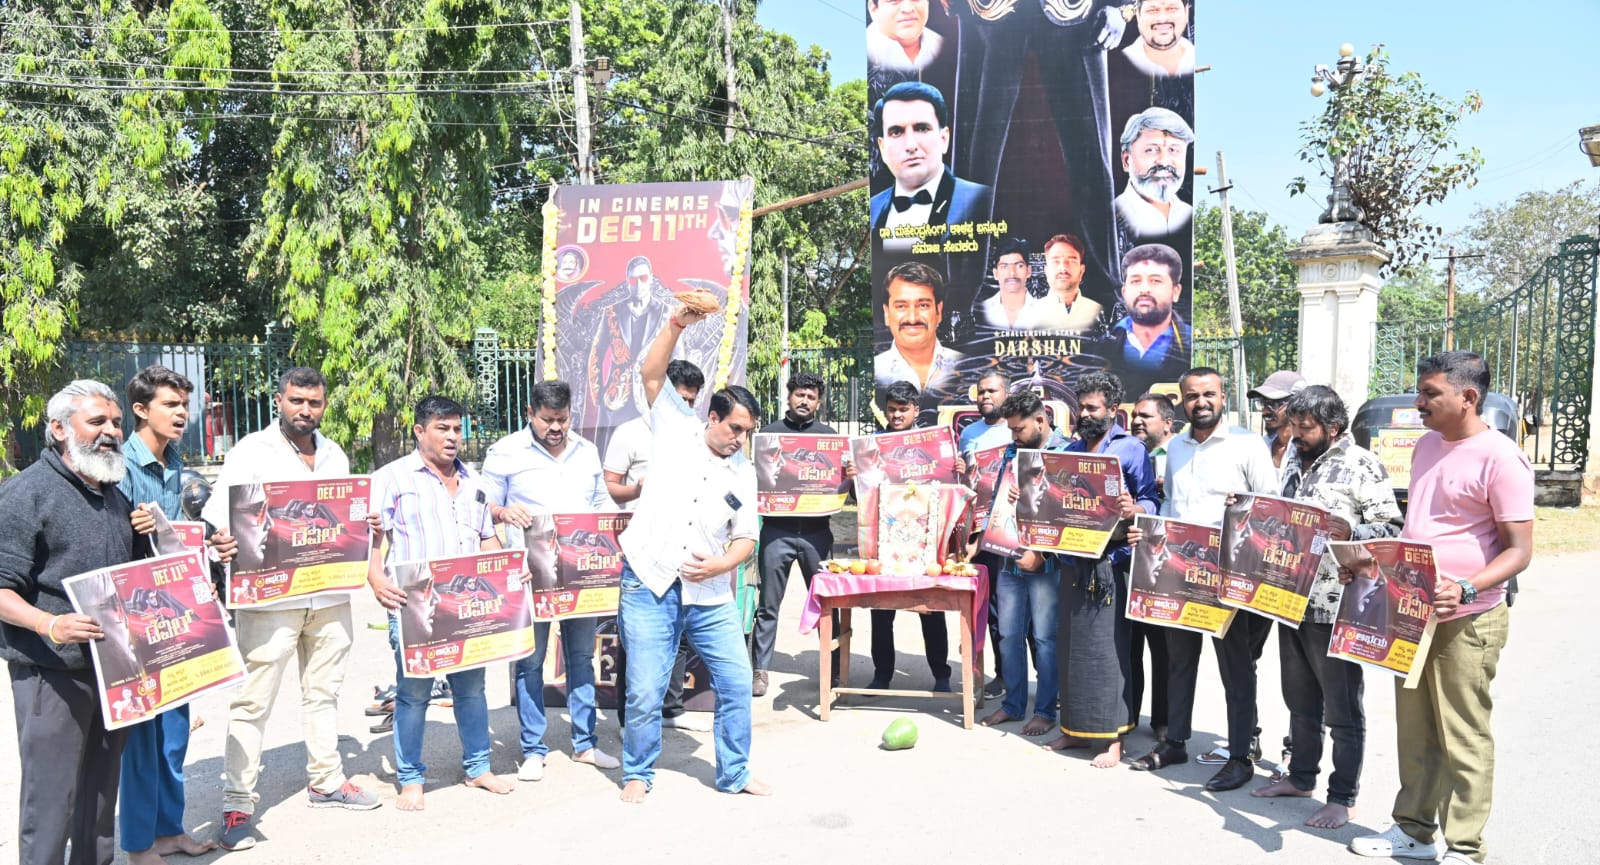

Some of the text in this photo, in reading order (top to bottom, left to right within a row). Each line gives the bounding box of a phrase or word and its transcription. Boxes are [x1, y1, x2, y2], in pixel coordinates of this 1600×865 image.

[579, 195, 709, 213] IN CINEMAS
[577, 214, 642, 243] DEC
[912, 240, 979, 255] ಸಮಾಜ ಸೇವಕರು
[1001, 329, 1074, 338] CHALLENGING STAR
[994, 339, 1081, 357] DARSHAN
[817, 440, 830, 451] DEC
[1078, 461, 1107, 475] DEC 11TH
[317, 485, 353, 501] DEC 11TH
[1062, 492, 1102, 511] ಡೆವಿಲ್
[598, 519, 613, 531] DEC
[1291, 510, 1321, 528] DEC 11TH
[292, 523, 345, 547] ಡೆವಿಲ್
[1209, 534, 1220, 548] DE
[1262, 542, 1304, 570] ಡೆವಿಲ್
[477, 558, 509, 574] DEC 11TH
[152, 564, 188, 587] DEC 11TH
[458, 594, 505, 620] ಡೆವಿಲ್
[145, 609, 194, 645] ಡೆವಿಲ್
